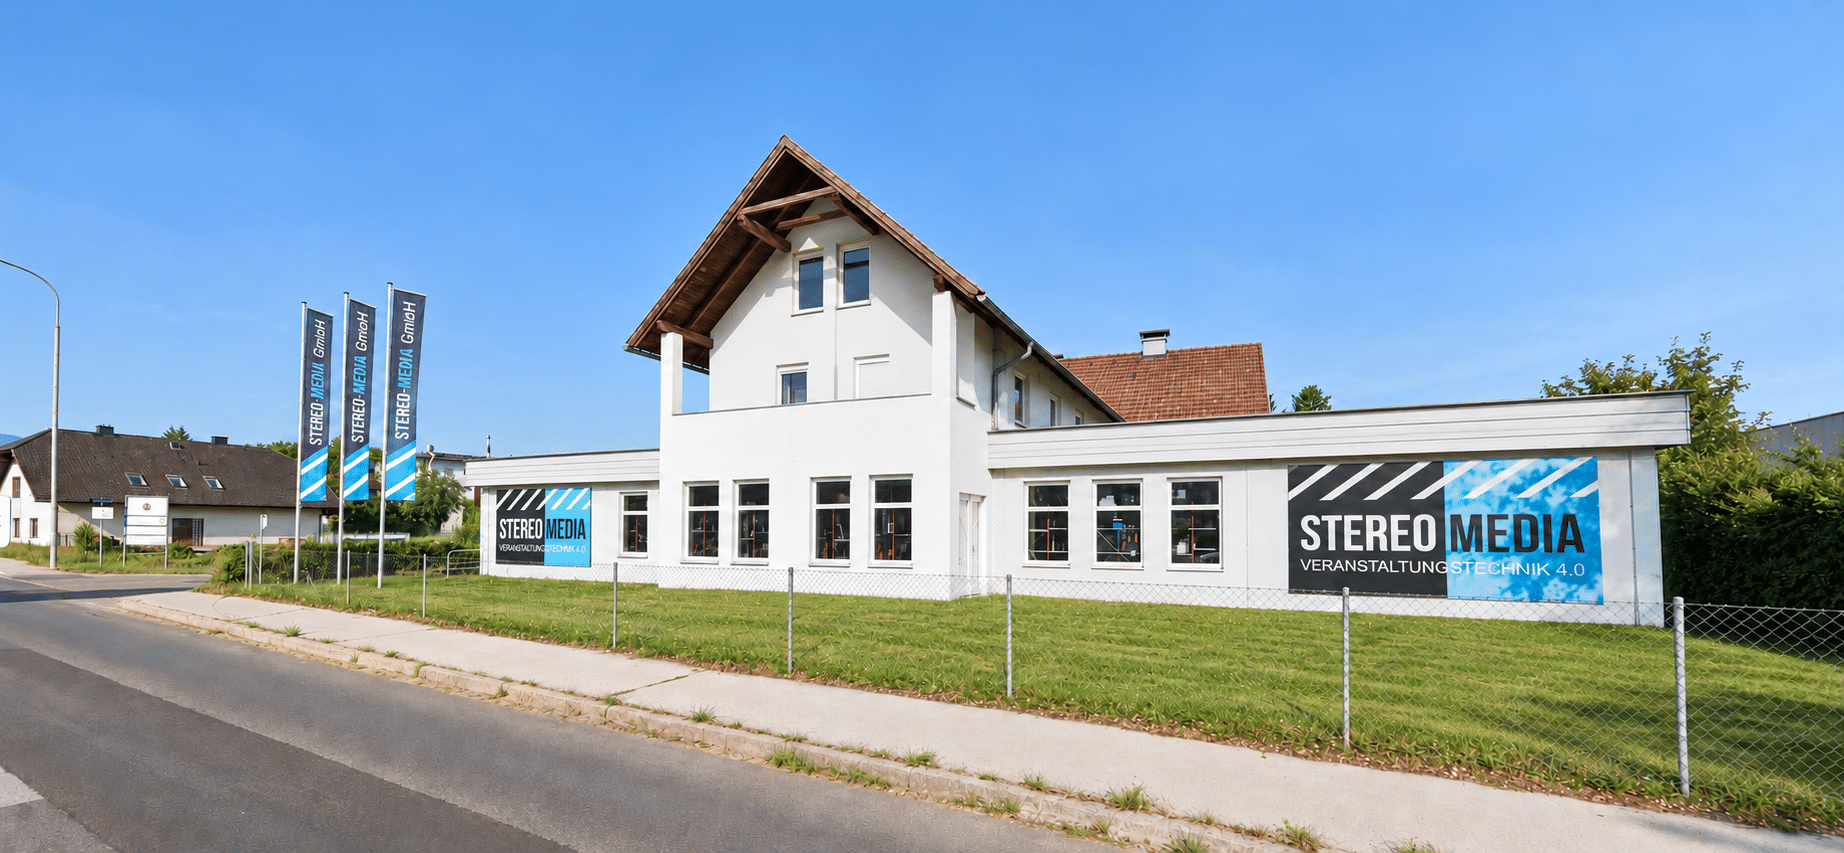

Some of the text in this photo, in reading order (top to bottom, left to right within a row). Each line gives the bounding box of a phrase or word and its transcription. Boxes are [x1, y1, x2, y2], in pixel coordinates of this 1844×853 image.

[309, 362, 325, 446] STEREO-MEDIA
[351, 355, 367, 443] STEREO-MEDIA
[395, 348, 413, 440] STEREO-MEDIA
[499, 518, 586, 540] STEREO MEDIA
[1300, 513, 1586, 553] STEREO MEDIA
[1300, 558, 1586, 577] VERANSTALTUNGSTECHNIK 4.0
